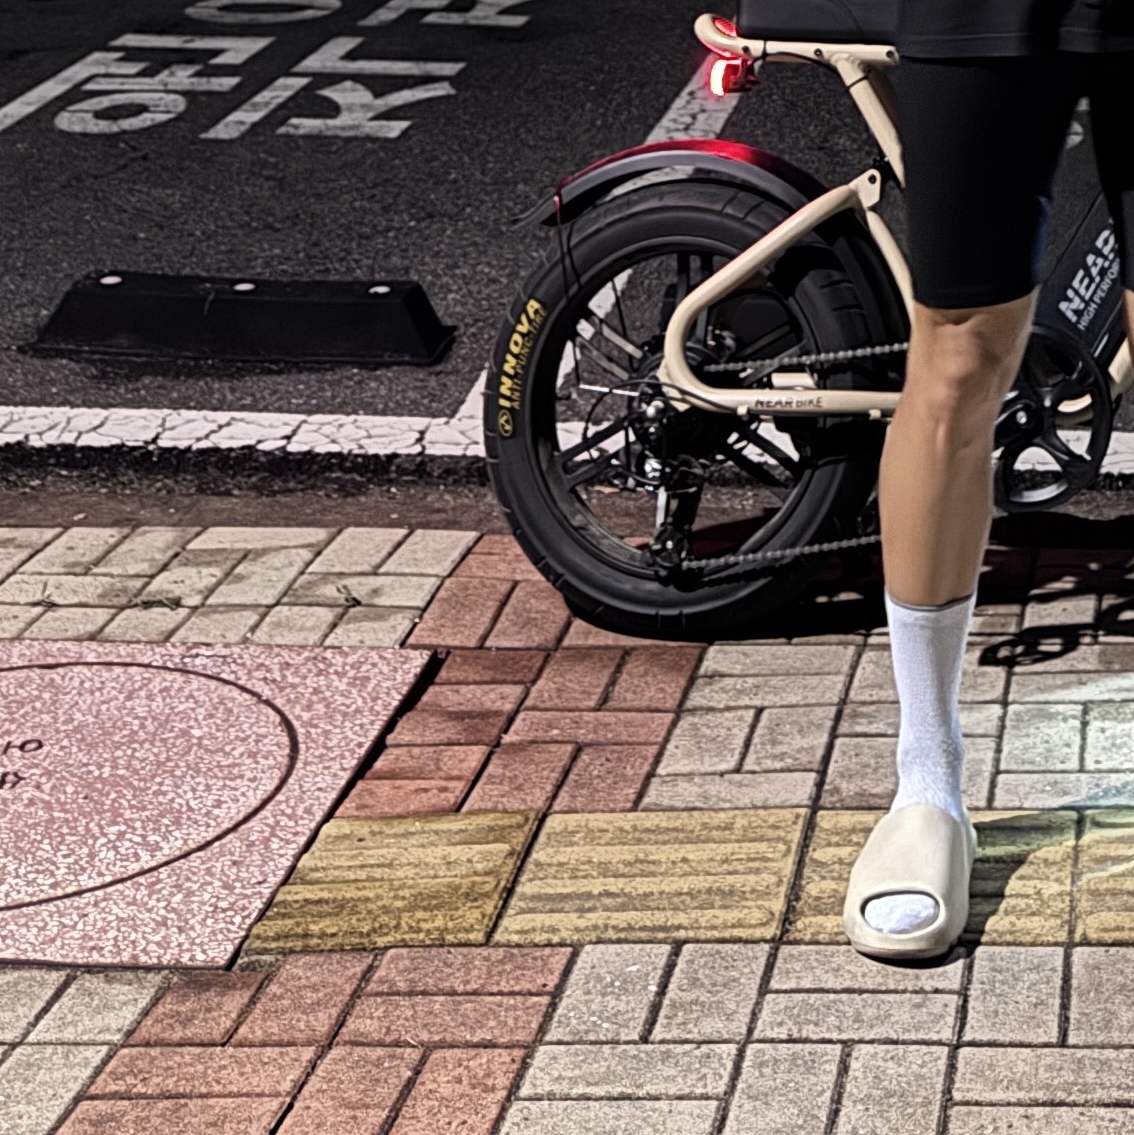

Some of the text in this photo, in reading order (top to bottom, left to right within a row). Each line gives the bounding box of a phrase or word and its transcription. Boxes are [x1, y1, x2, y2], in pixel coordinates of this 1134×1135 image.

[0, 34, 468, 140] 직원
[1076, 301, 1099, 331] HIGH
[498, 298, 545, 408] INNOVA
[755, 396, 823, 408] NEAR BIKE
